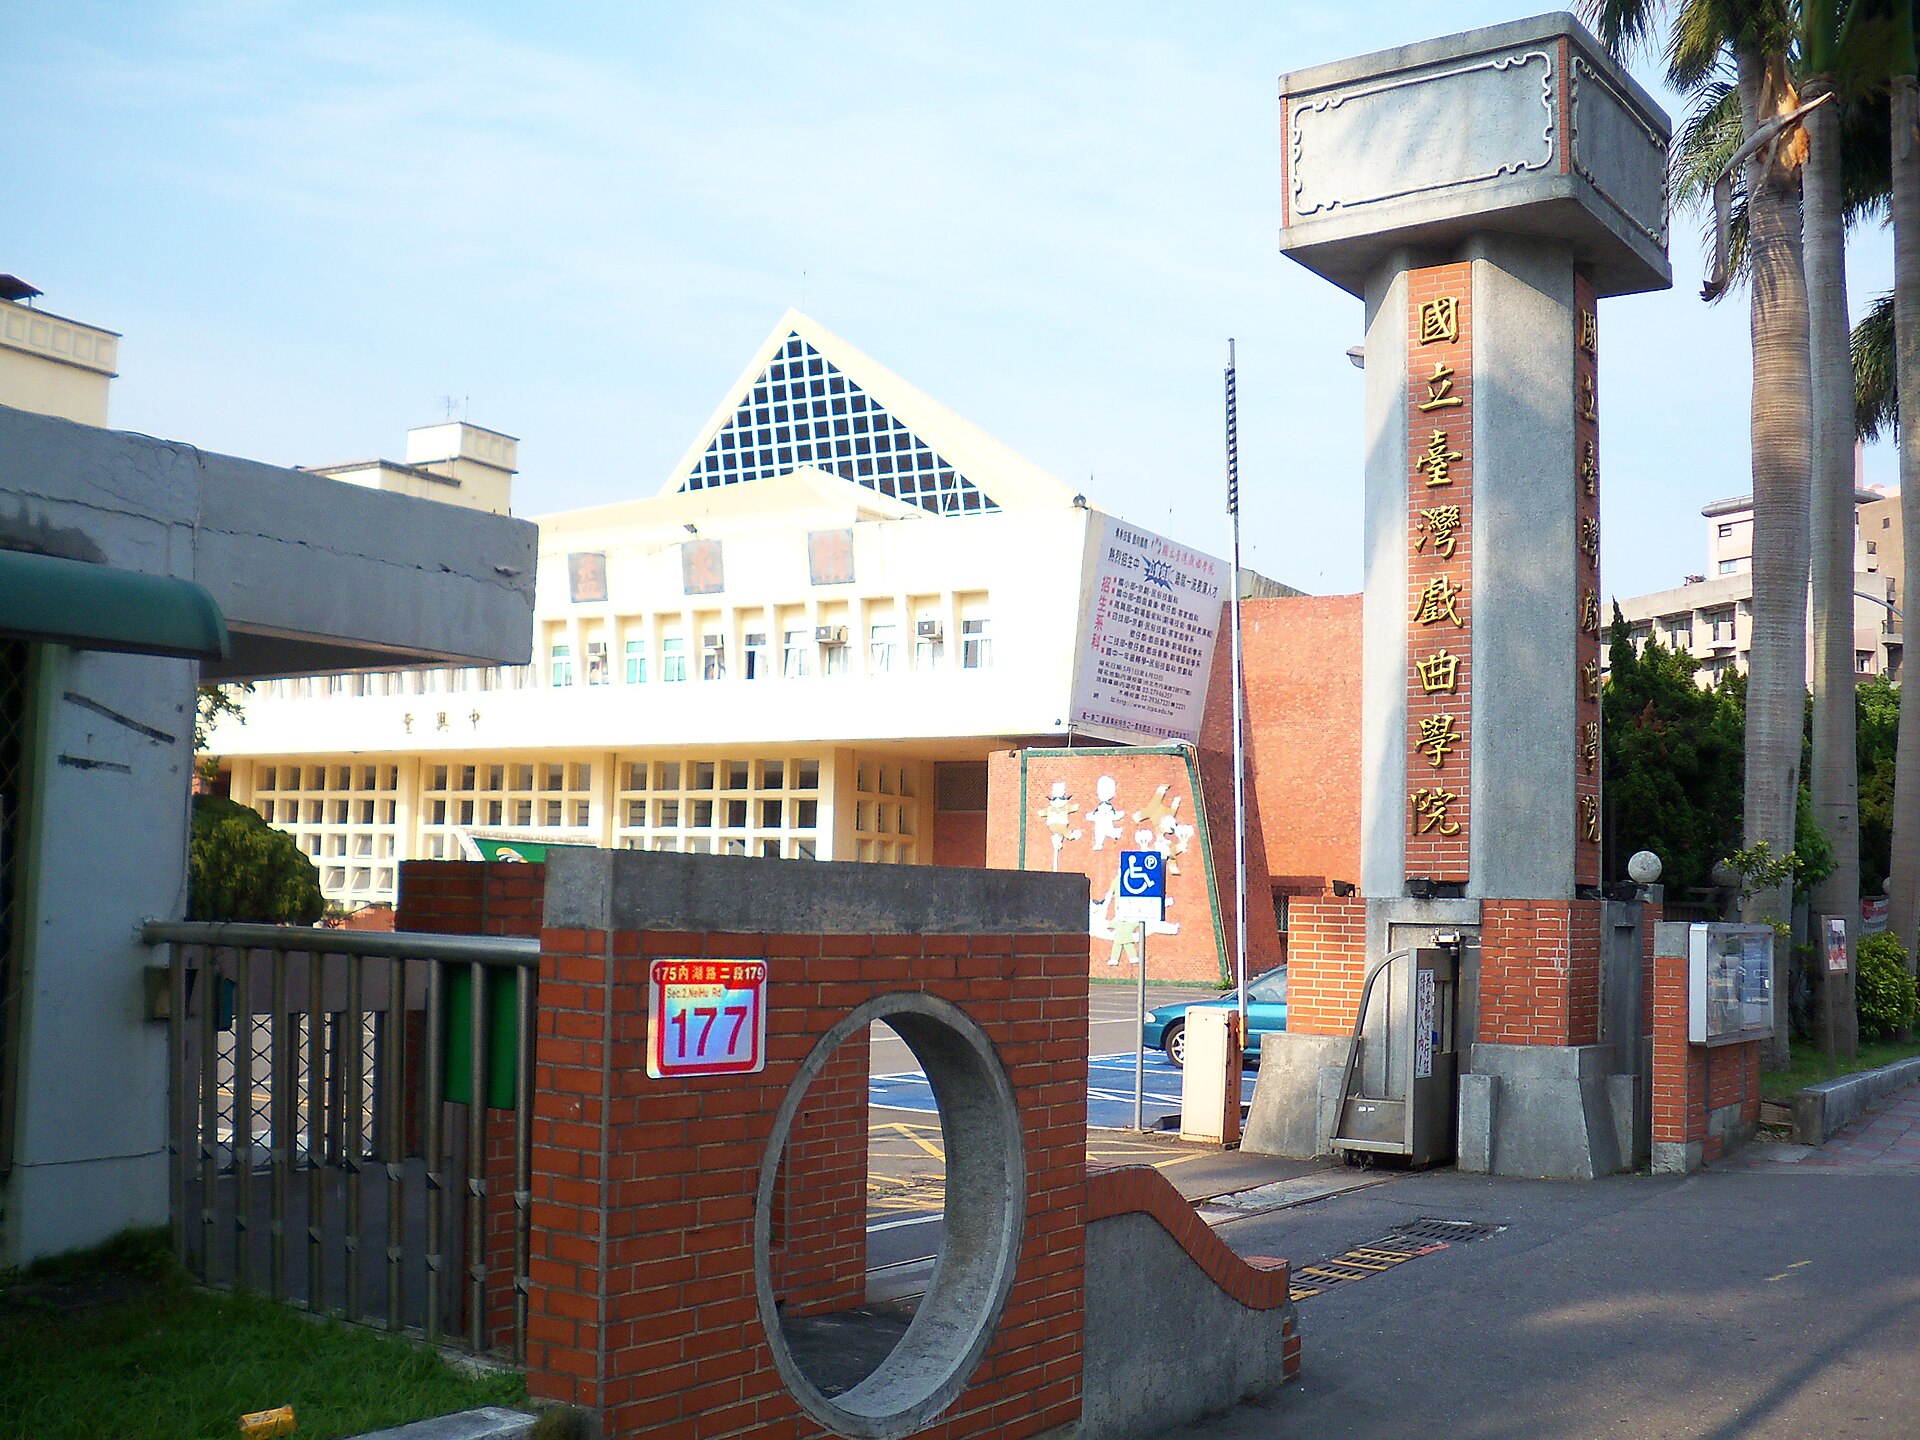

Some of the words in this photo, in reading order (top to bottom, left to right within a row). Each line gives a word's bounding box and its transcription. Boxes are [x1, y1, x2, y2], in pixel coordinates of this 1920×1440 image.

[1411, 296, 1464, 837] 國立臺灣戲曲學院
[1091, 575, 1111, 650] 招生系科
[671, 1006, 748, 1058] 177
